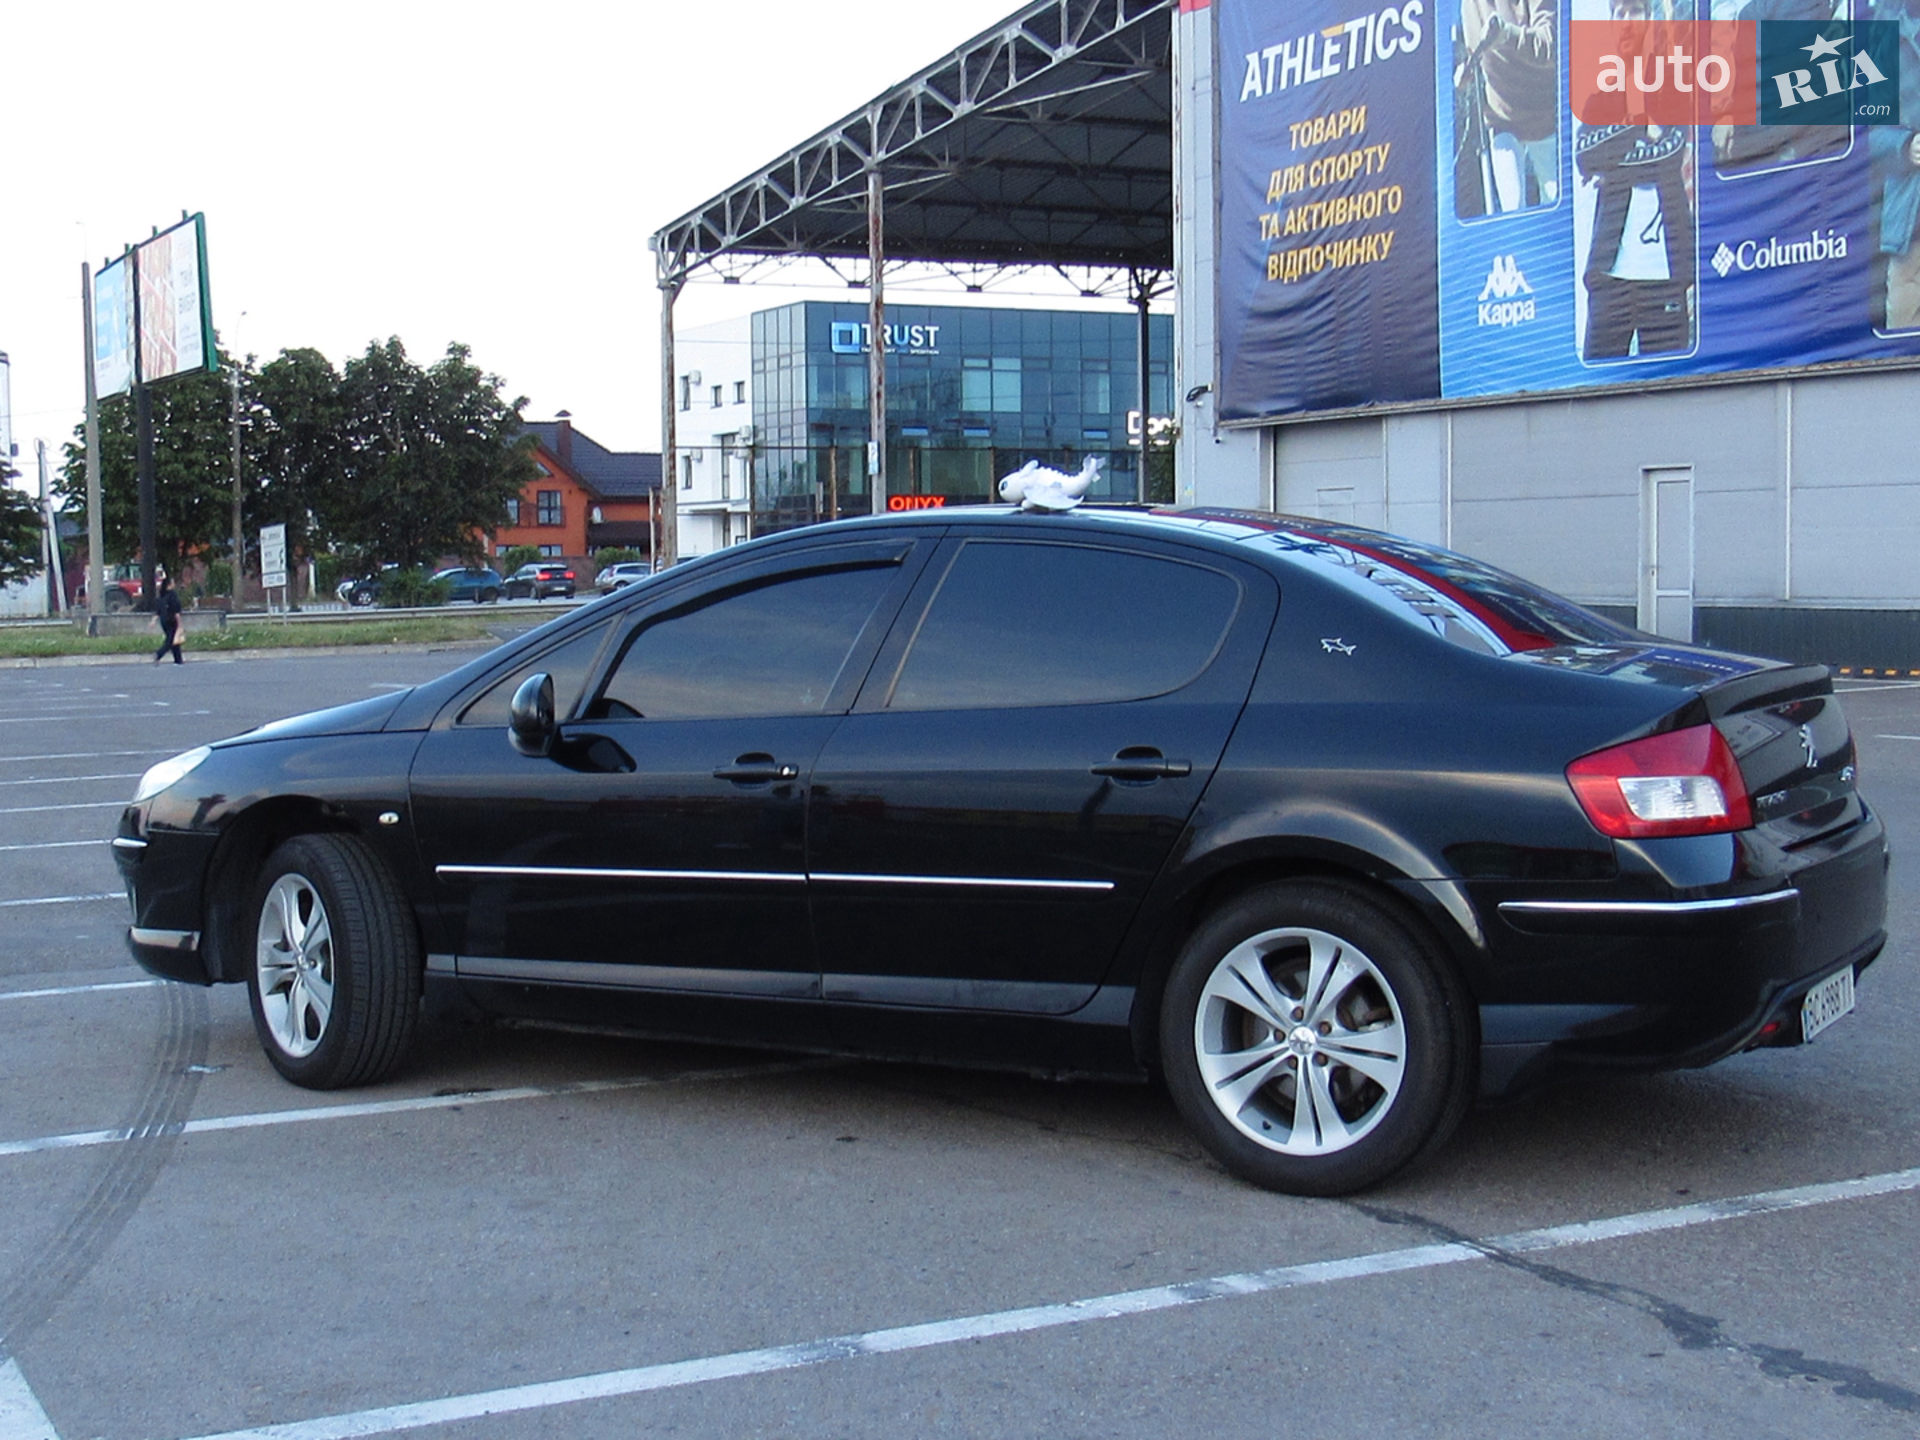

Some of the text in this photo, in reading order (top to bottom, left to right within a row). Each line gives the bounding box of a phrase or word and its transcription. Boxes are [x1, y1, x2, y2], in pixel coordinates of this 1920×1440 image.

[1240, 0, 1424, 103] ATHLETICS
[1289, 105, 1367, 151] ТОВАРИ
[1266, 142, 1391, 204] ДЛЯ СПОРТУ
[1259, 185, 1403, 241] ТА АКТИВНОГО
[1267, 230, 1395, 285] ВІДПОЧИНКУ
[1736, 229, 1848, 271] Columbia
[1478, 296, 1536, 328] Kappa
[861, 323, 940, 348] TRUST
[890, 496, 945, 511] ONYX
